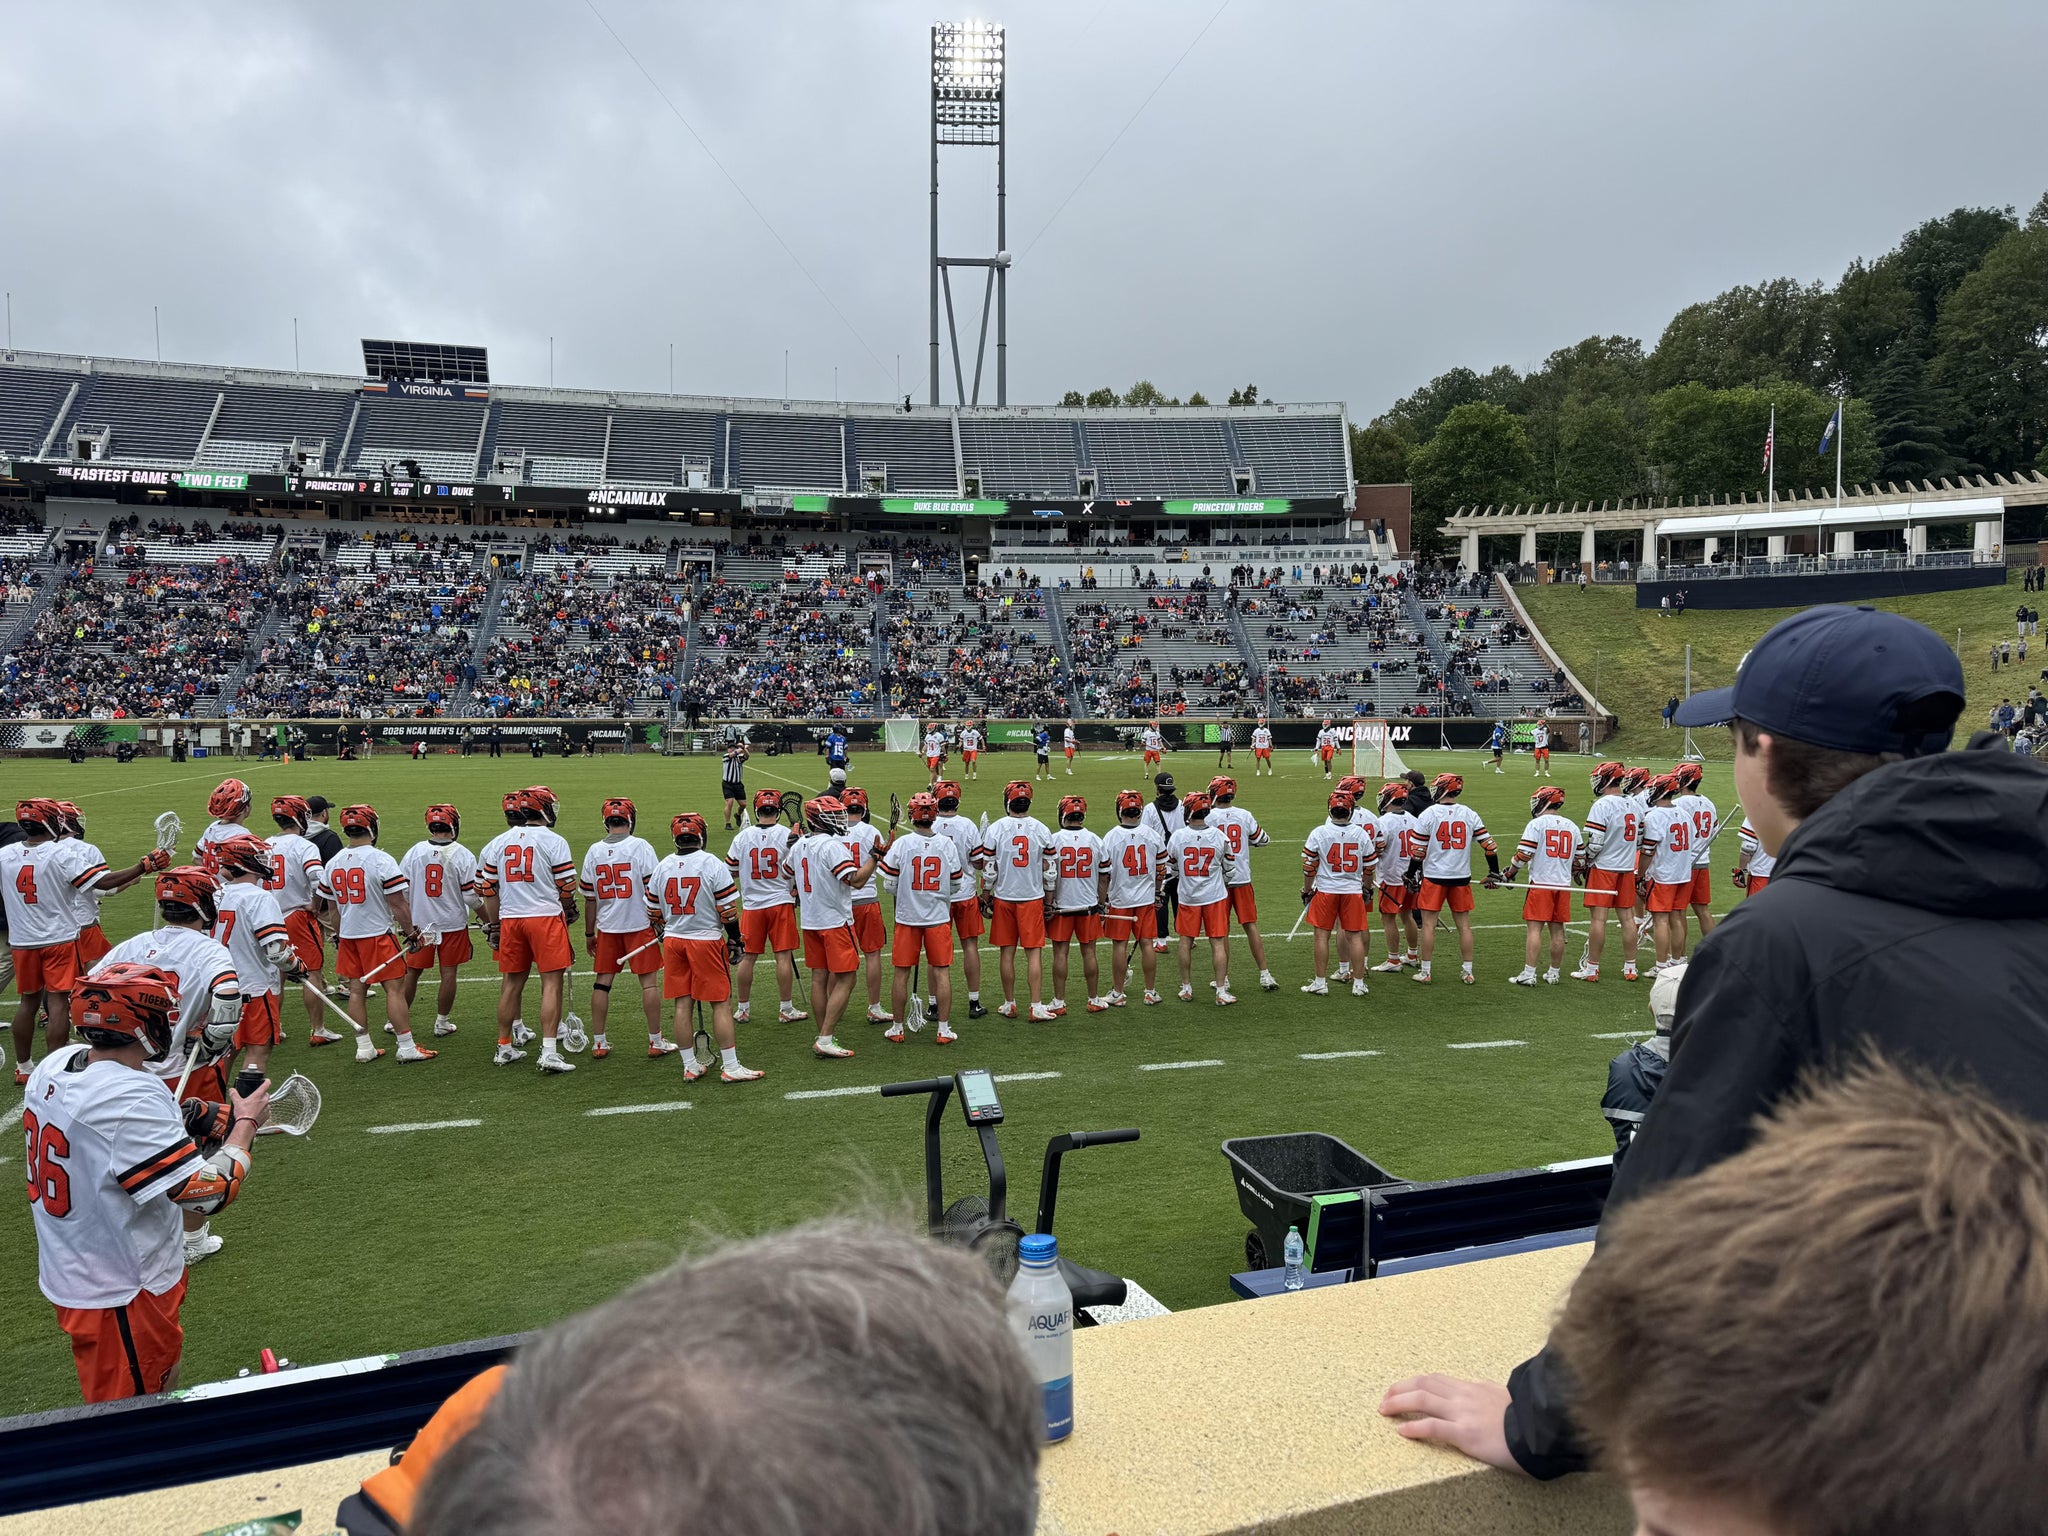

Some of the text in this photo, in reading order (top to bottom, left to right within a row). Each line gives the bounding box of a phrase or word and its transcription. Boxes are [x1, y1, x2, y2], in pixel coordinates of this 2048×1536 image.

[400, 384, 453, 397] VIRGINIA
[58, 466, 245, 488] THE FASTEST GAME ON TWO FEET
[305, 480, 355, 492] PRINCETON
[373, 482, 381, 493] 2
[423, 485, 431, 495] 0
[451, 486, 474, 497] DUKE
[587, 489, 667, 507] #NCAAMLAX
[913, 501, 975, 513] DUKE BLUE DEVILS
[1192, 501, 1265, 513] PRINCETON TIGERS
[382, 726, 405, 735] 2026
[405, 726, 428, 735] NCAA
[428, 726, 455, 735] MEN'S
[1217, 824, 1242, 853] 8
[1435, 821, 1467, 850] 49
[1624, 813, 1637, 842] 6
[1669, 821, 1690, 852] 31
[1012, 835, 1030, 868] 3
[1326, 842, 1359, 873] 45
[1545, 829, 1572, 860] 50
[263, 854, 286, 891] 9
[504, 844, 535, 883] 21
[749, 847, 778, 880] 13
[801, 857, 812, 893] 1
[911, 855, 942, 891] 12
[1060, 846, 1093, 878] 22
[1122, 844, 1149, 877] 41
[1183, 847, 1215, 877] 27
[15, 864, 38, 905] 4
[330, 867, 366, 905] 99
[425, 863, 444, 898] 8
[596, 862, 633, 900] 25
[664, 876, 701, 916] 47
[210, 909, 237, 949] 7
[87, 1000, 100, 1011] 36
[138, 992, 169, 1009] TIGERS
[43, 1083, 56, 1101] P
[22, 1107, 72, 1218] 36
